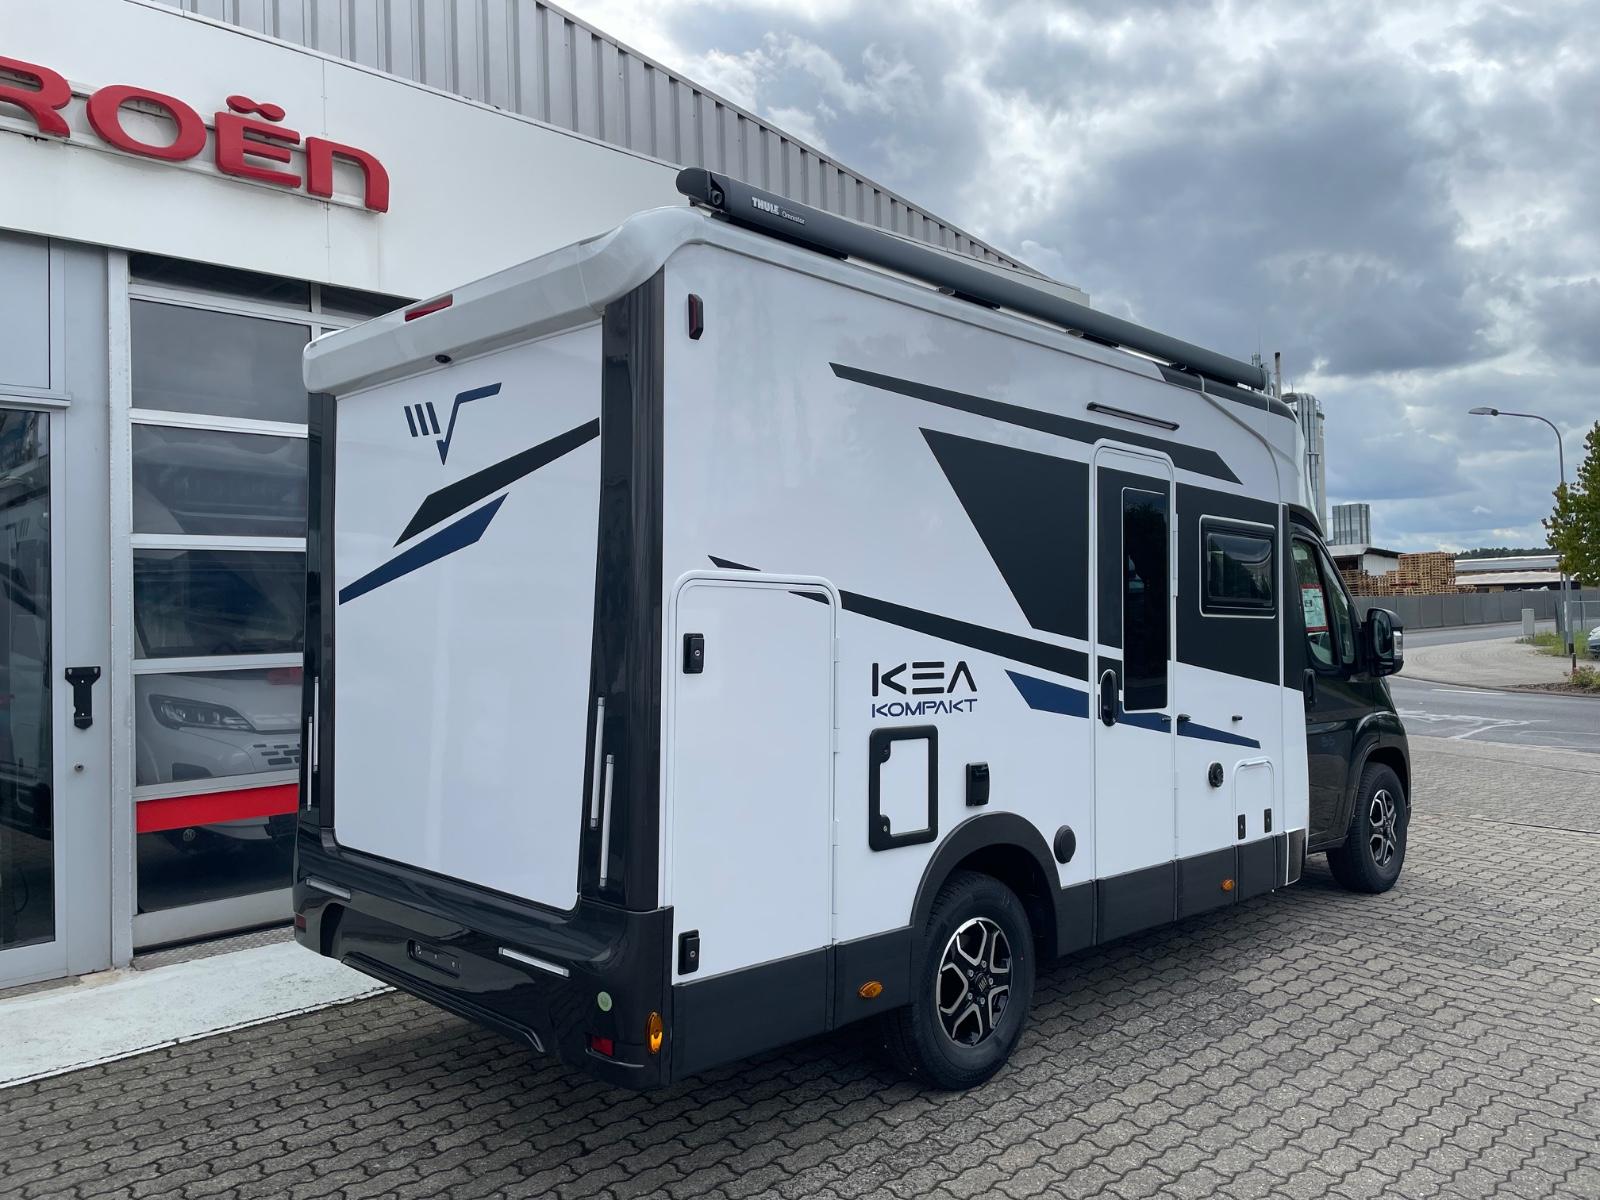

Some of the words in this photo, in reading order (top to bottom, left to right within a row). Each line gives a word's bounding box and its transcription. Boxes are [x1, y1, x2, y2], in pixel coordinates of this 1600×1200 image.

[751, 196, 780, 216] THULE
[871, 660, 978, 697] KEA
[871, 698, 978, 718] KOMPAKT
